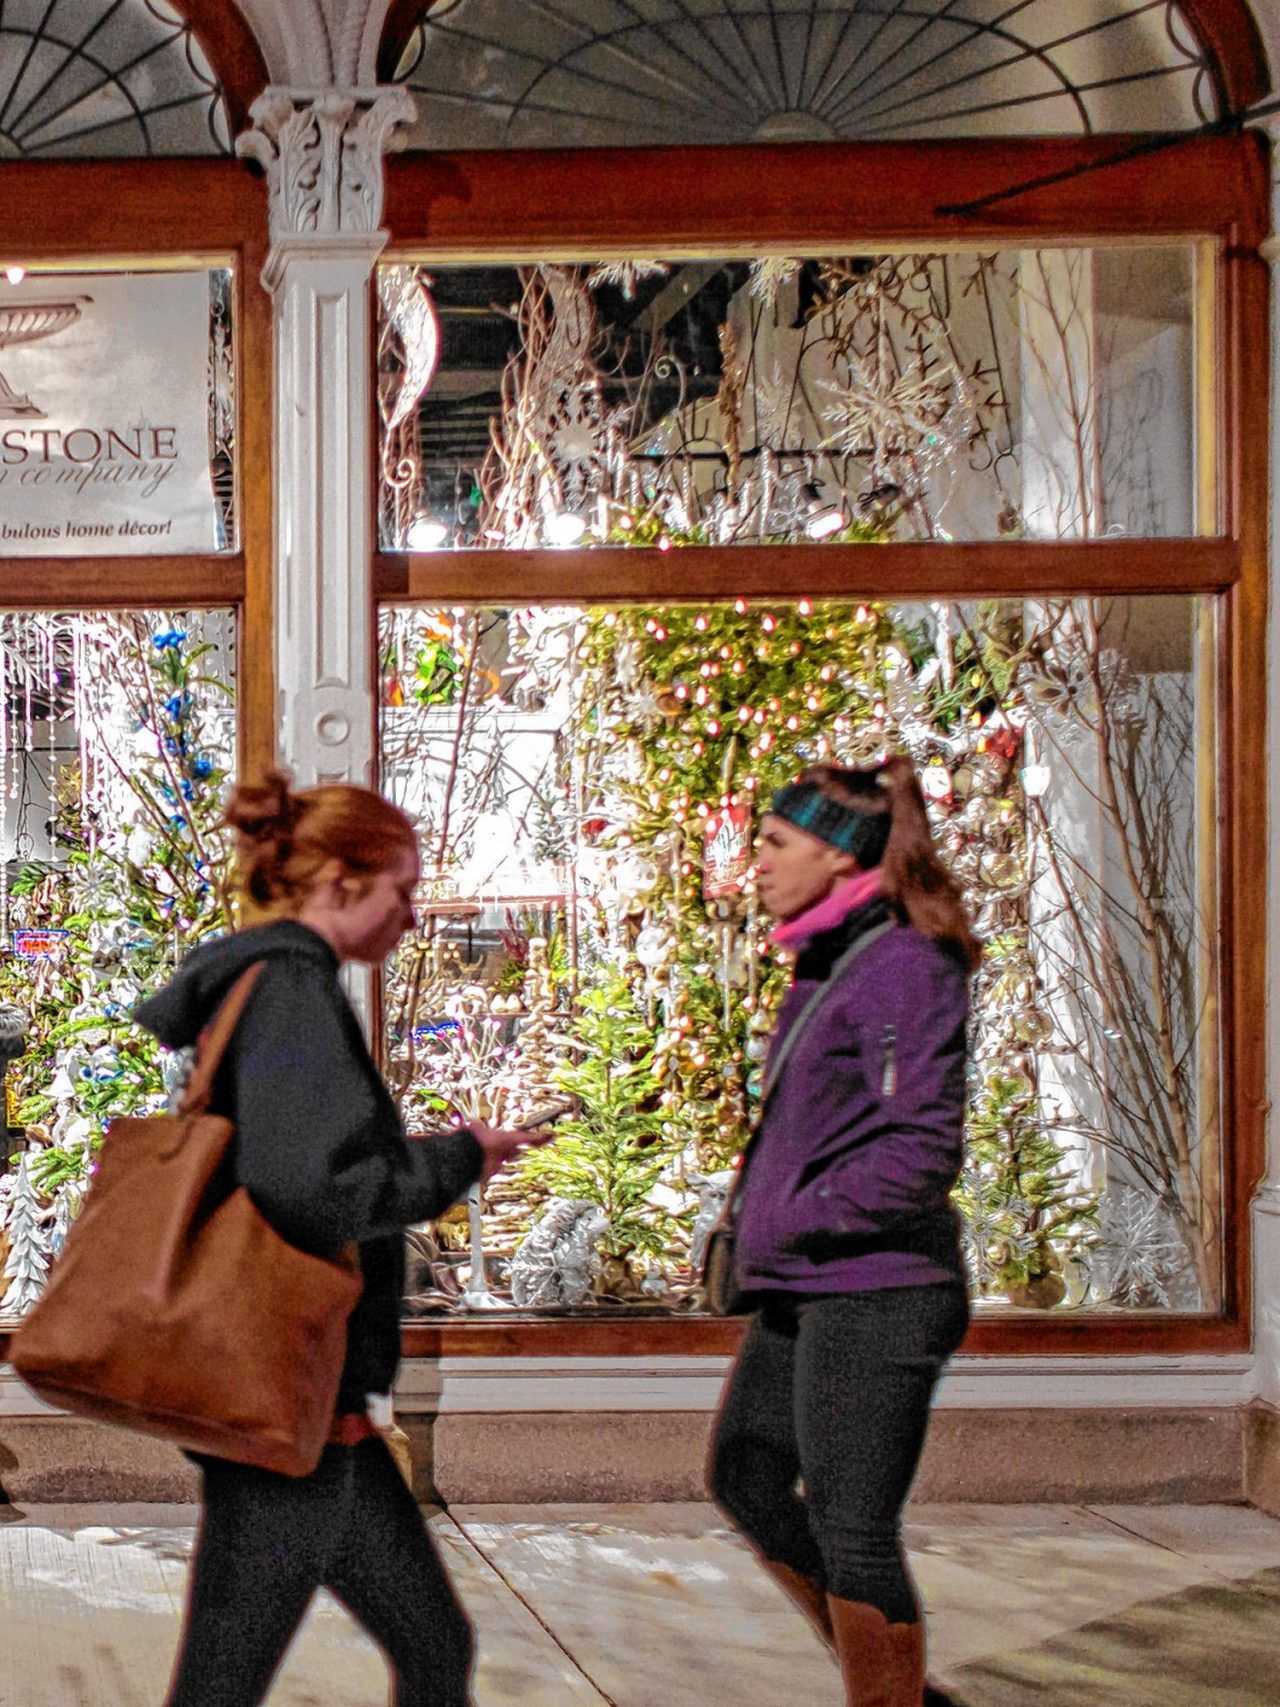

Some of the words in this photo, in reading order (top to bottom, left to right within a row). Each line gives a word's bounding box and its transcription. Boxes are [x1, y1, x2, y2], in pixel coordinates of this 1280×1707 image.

[20, 458, 175, 498] company
[65, 521, 114, 538] home
[118, 519, 172, 537] décor!
